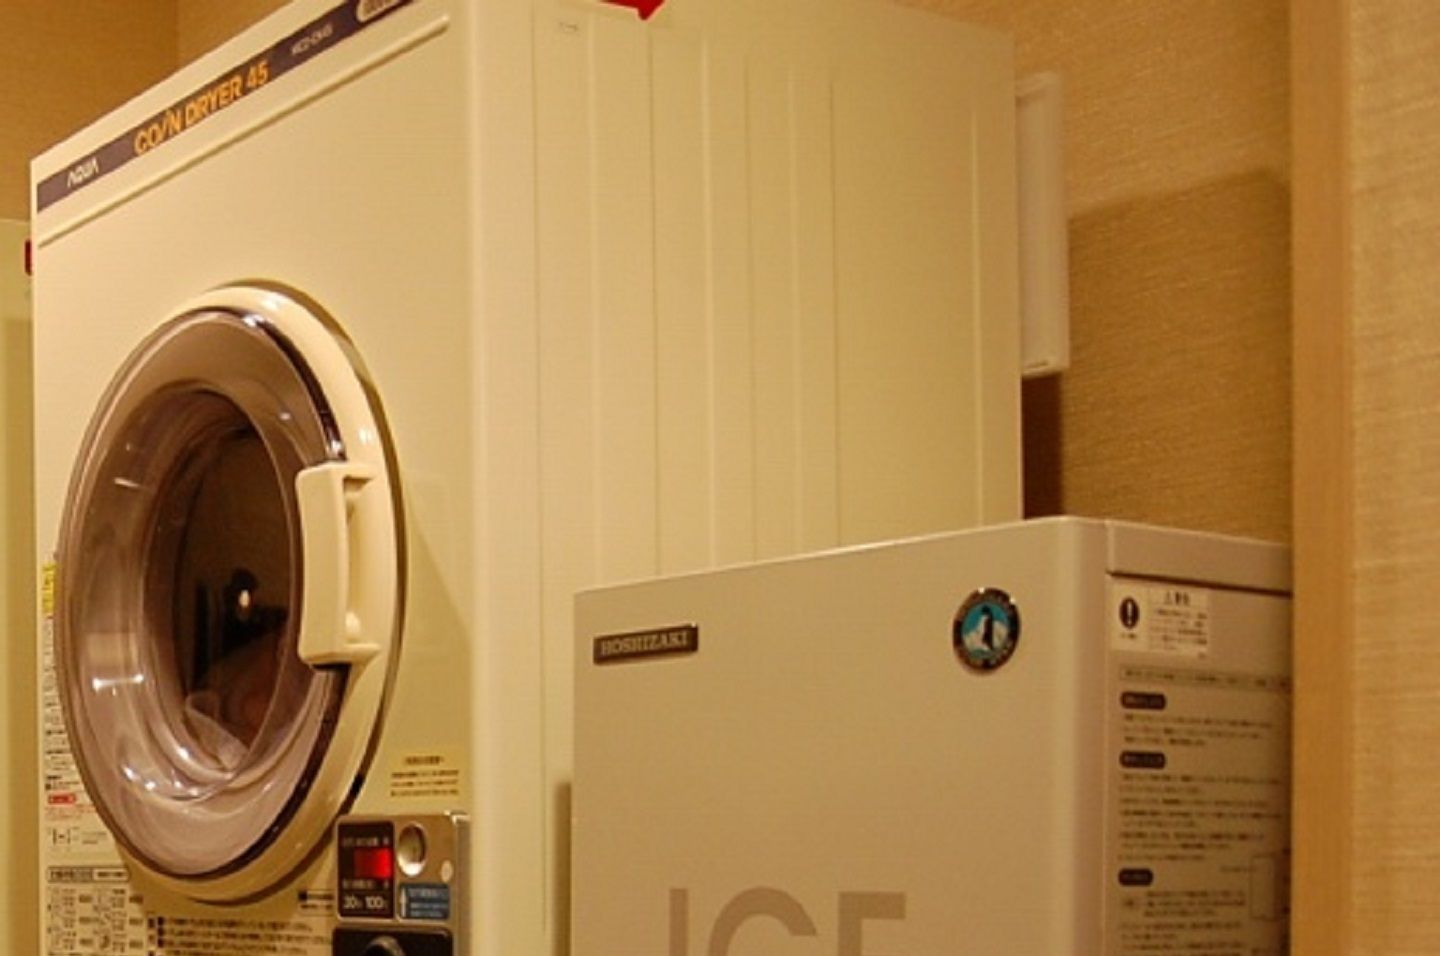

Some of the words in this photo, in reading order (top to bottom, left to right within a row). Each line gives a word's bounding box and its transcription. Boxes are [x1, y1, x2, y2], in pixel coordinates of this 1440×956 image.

[185, 76, 243, 126] DRYER
[246, 60, 270, 89] 45
[599, 631, 688, 656] HOSHIZAKI
